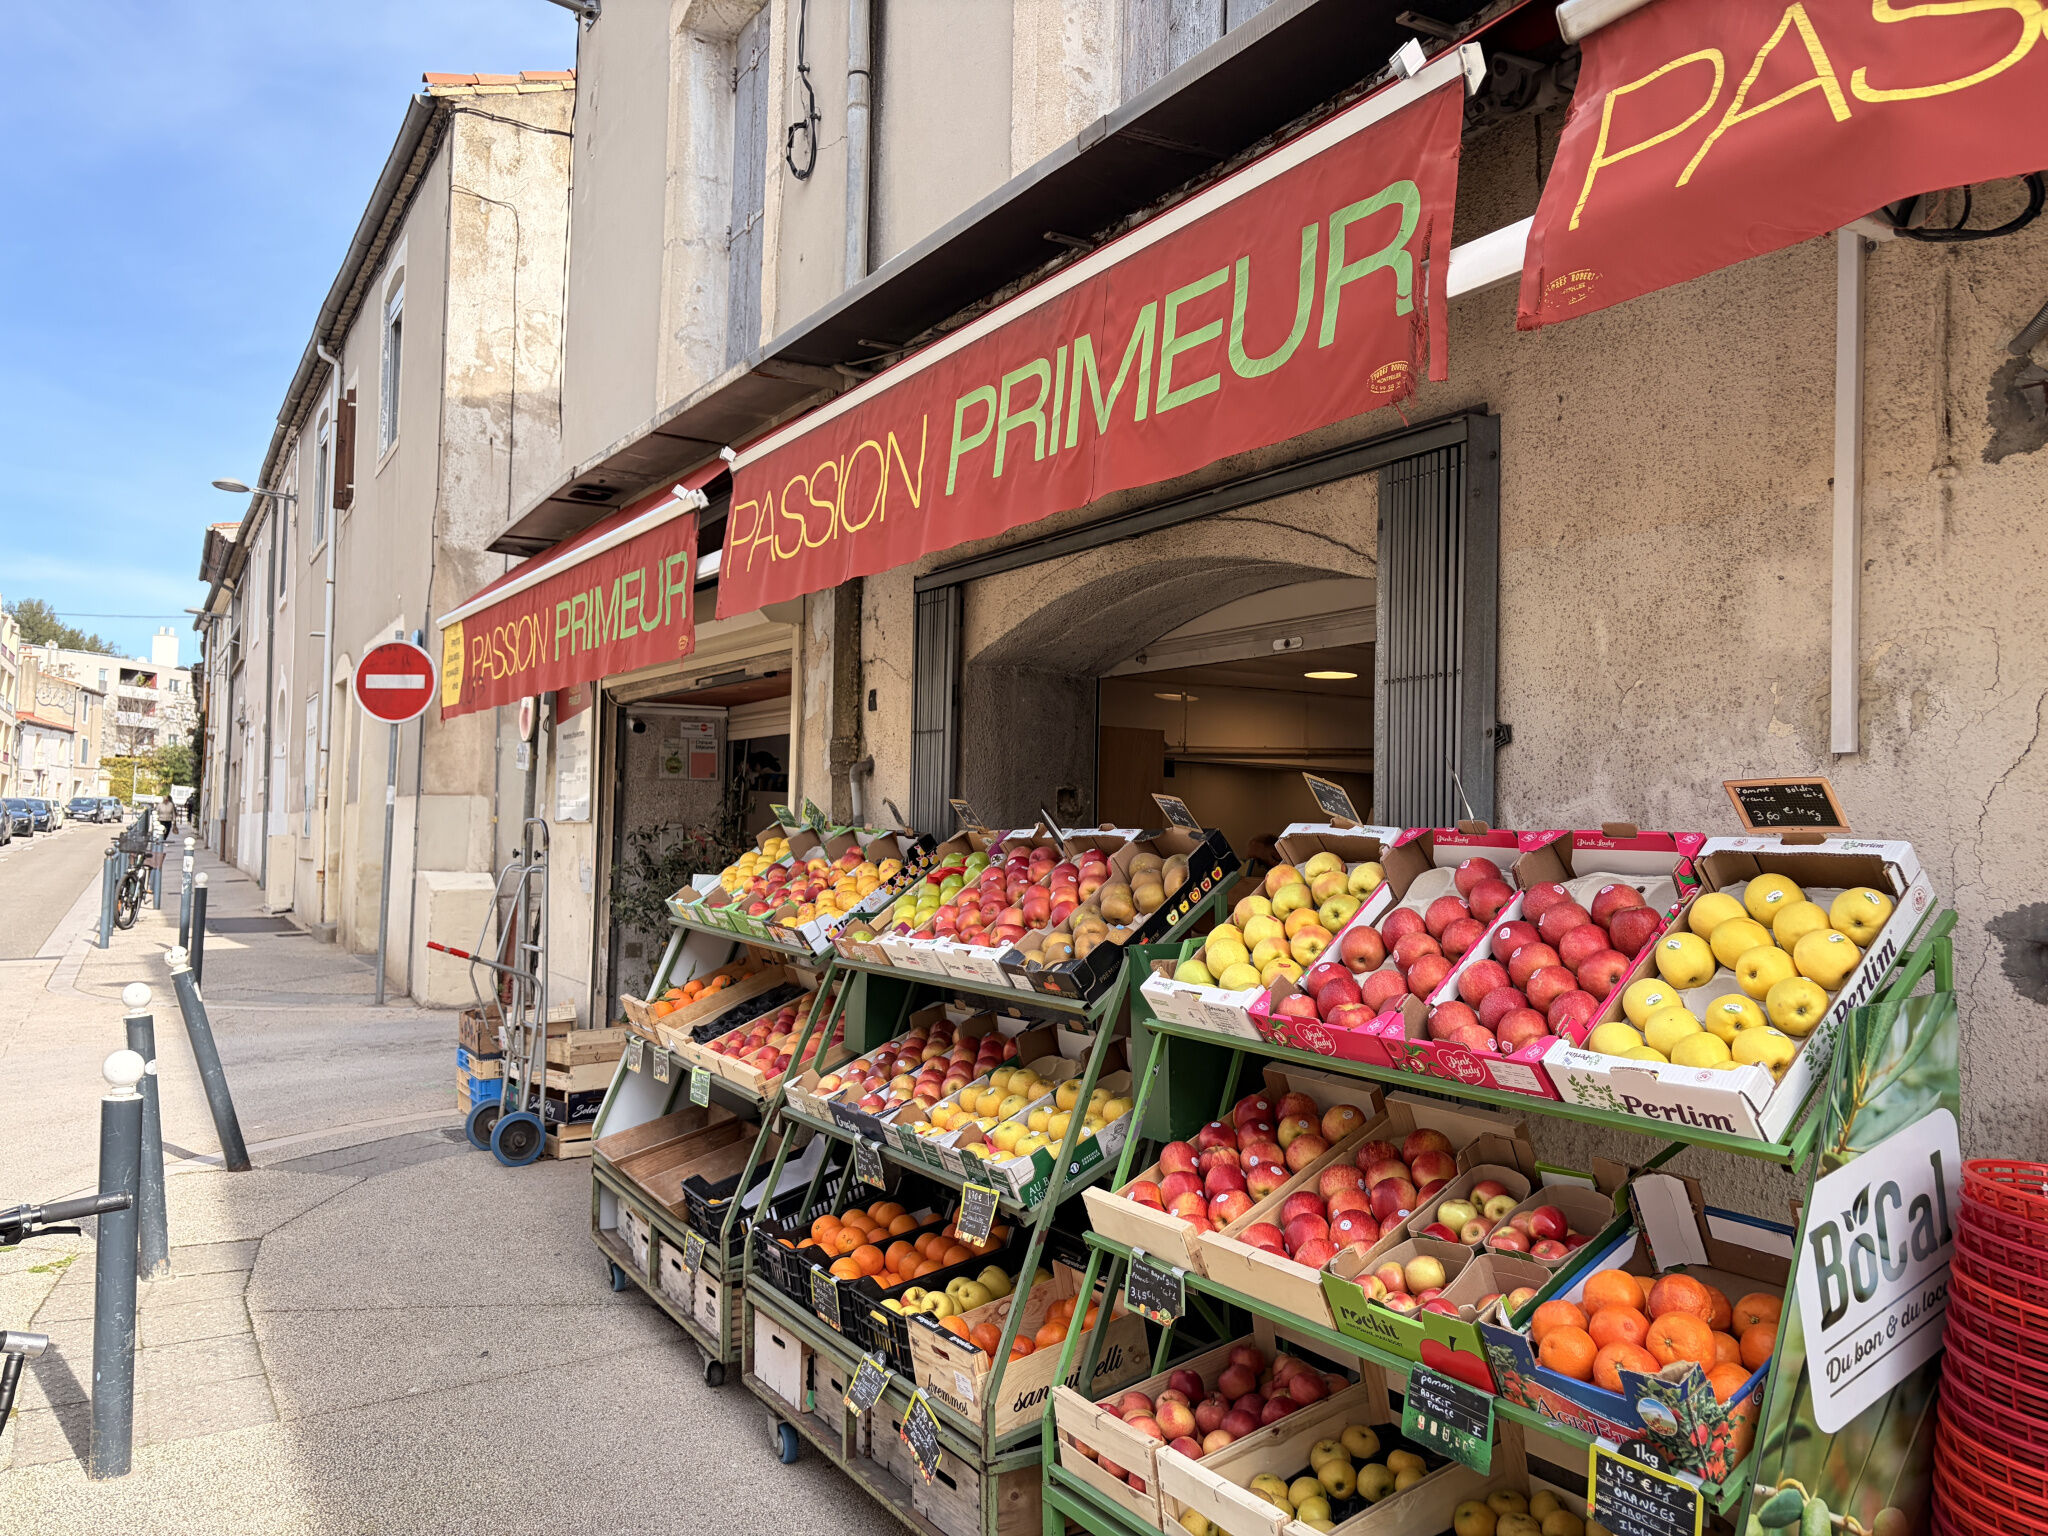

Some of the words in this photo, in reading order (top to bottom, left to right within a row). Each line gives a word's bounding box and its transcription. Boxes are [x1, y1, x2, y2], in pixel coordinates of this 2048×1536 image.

[1568, 0, 2048, 231] PAS
[726, 413, 928, 579] PASSION
[945, 179, 1421, 496] PRIMEUR
[472, 607, 549, 688] PASSION
[554, 551, 689, 662] PRIMEUR
[1577, 837, 1596, 847] Pink
[1596, 839, 1617, 848] Lady
[1302, 1028, 1325, 1041] Pink
[1313, 1037, 1333, 1050] Lady
[1446, 1054, 1473, 1068] Pink
[1457, 1065, 1482, 1077] Lady
[1619, 1093, 1737, 1133] Perlim
[1339, 1306, 1400, 1340] rockit
[1826, 1356, 1852, 1384] Du
[1854, 1330, 1885, 1368] bon
[1886, 1314, 1899, 1339] &
[1901, 1299, 1921, 1329] du
[1013, 1343, 1124, 1413] sanuielli
[1633, 1443, 1659, 1469] 1kg
[1614, 1486, 1676, 1522] ORANGES
